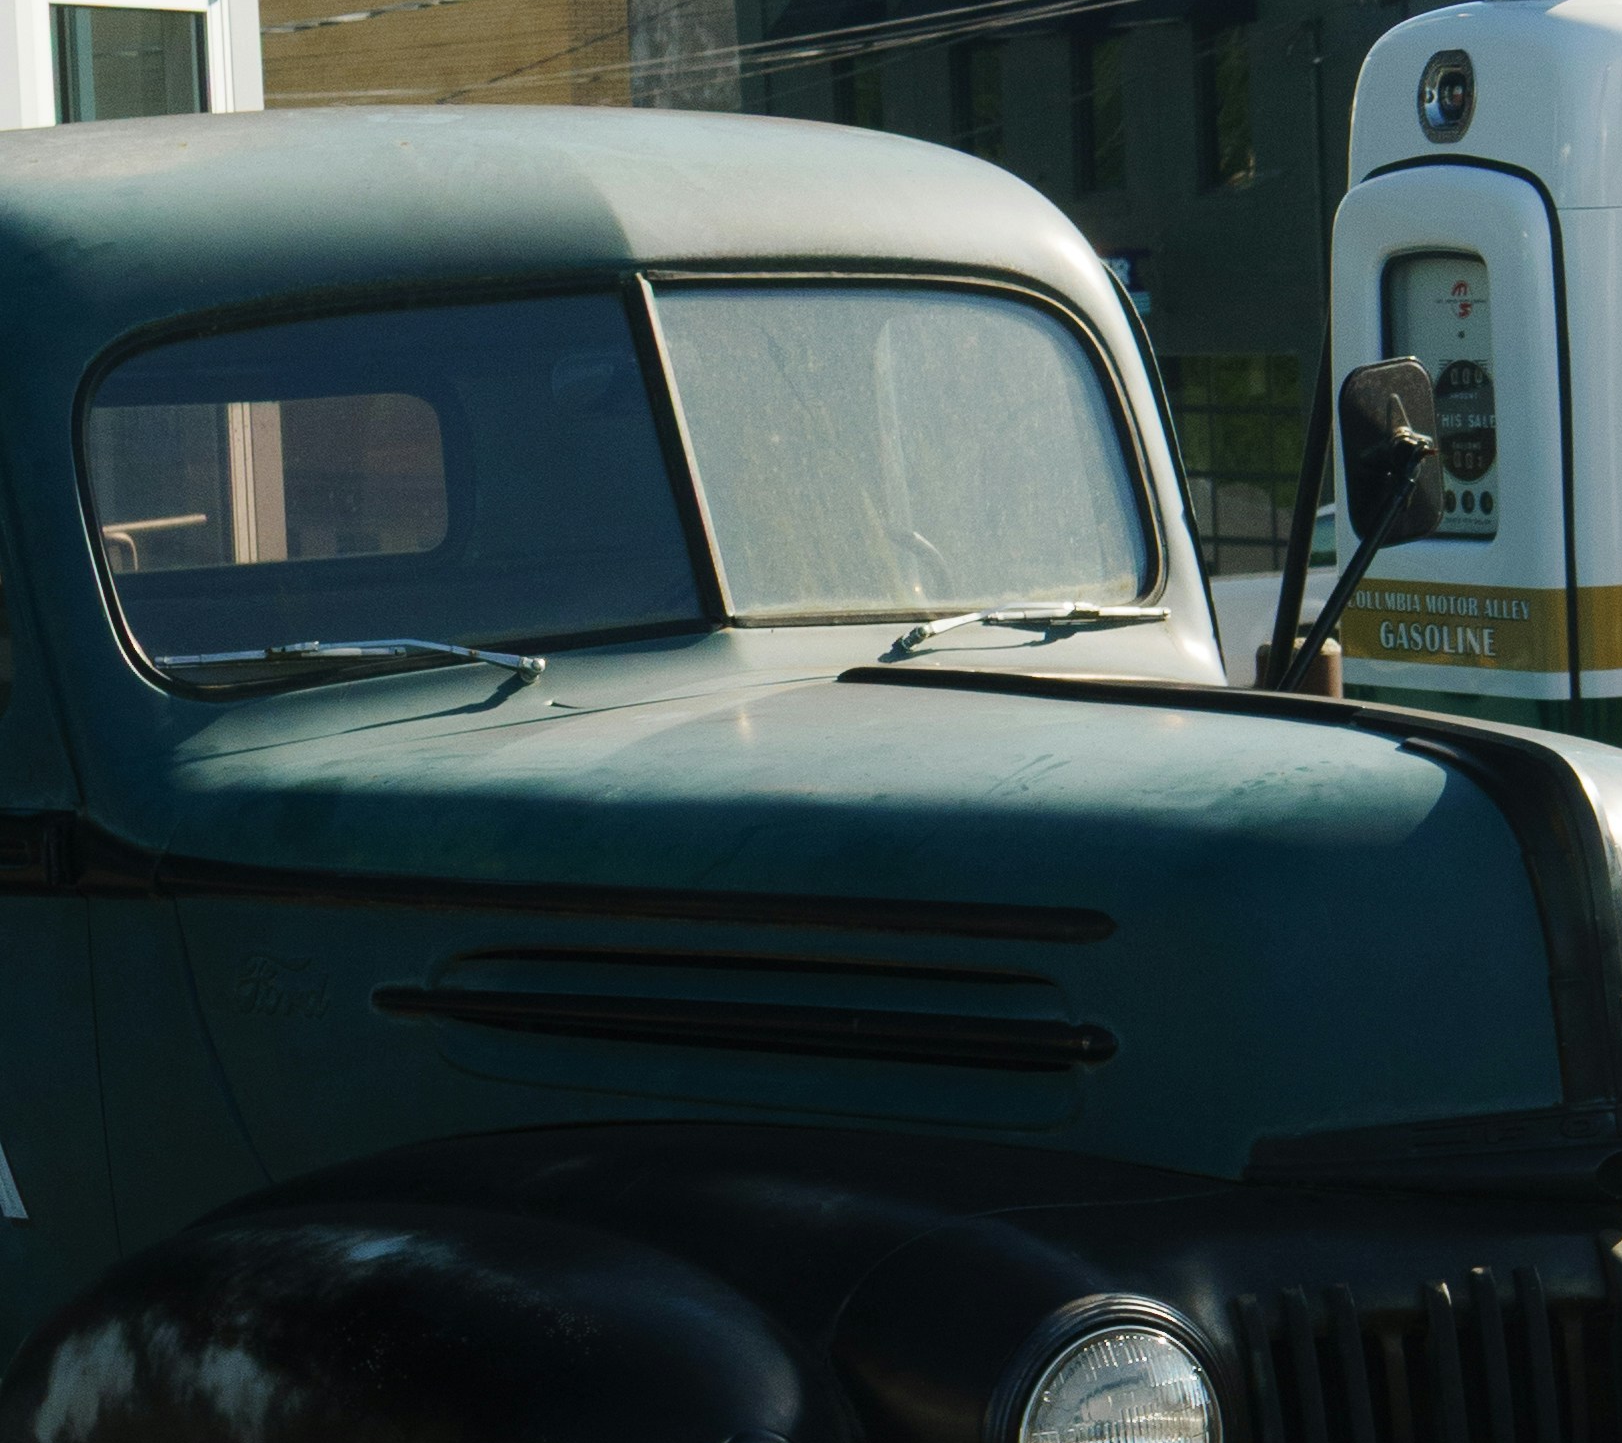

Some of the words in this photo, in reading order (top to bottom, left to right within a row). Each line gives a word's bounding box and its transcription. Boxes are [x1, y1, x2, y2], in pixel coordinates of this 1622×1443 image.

[1437, 413, 1462, 428] HIS
[1467, 414, 1497, 429] SALE
[1425, 594, 1479, 617] MOTOR
[1483, 598, 1531, 621] ALLEY
[1379, 620, 1496, 657] GASOLINE
